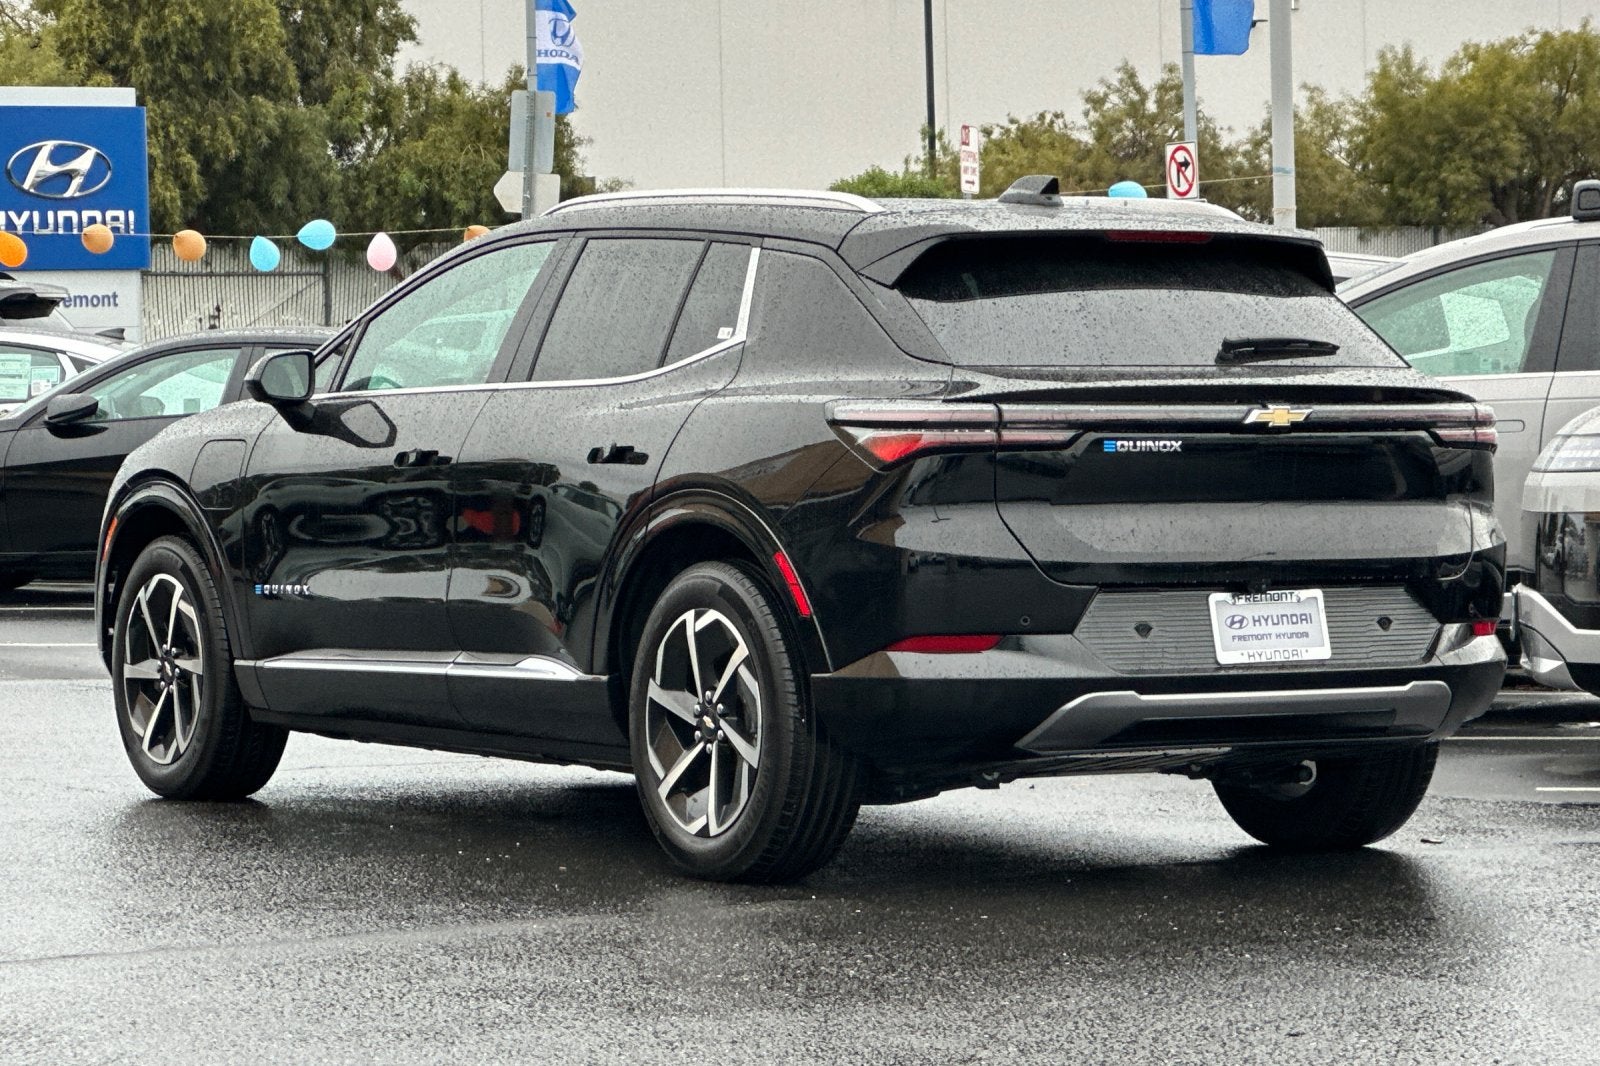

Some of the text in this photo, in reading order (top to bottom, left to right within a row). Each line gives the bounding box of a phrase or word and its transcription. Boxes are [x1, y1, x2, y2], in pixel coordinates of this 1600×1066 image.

[0, 210, 135, 235] YUNDAI
[57, 291, 119, 308] emont
[1103, 440, 1182, 452] EQUINOX
[254, 584, 310, 596] EQUINOX
[1237, 591, 1295, 603] FREMONT
[1251, 612, 1313, 627] HYUNDAI
[1231, 631, 1310, 643] FREMONT HYUNDAI
[1246, 648, 1304, 661] HYUNDAI
